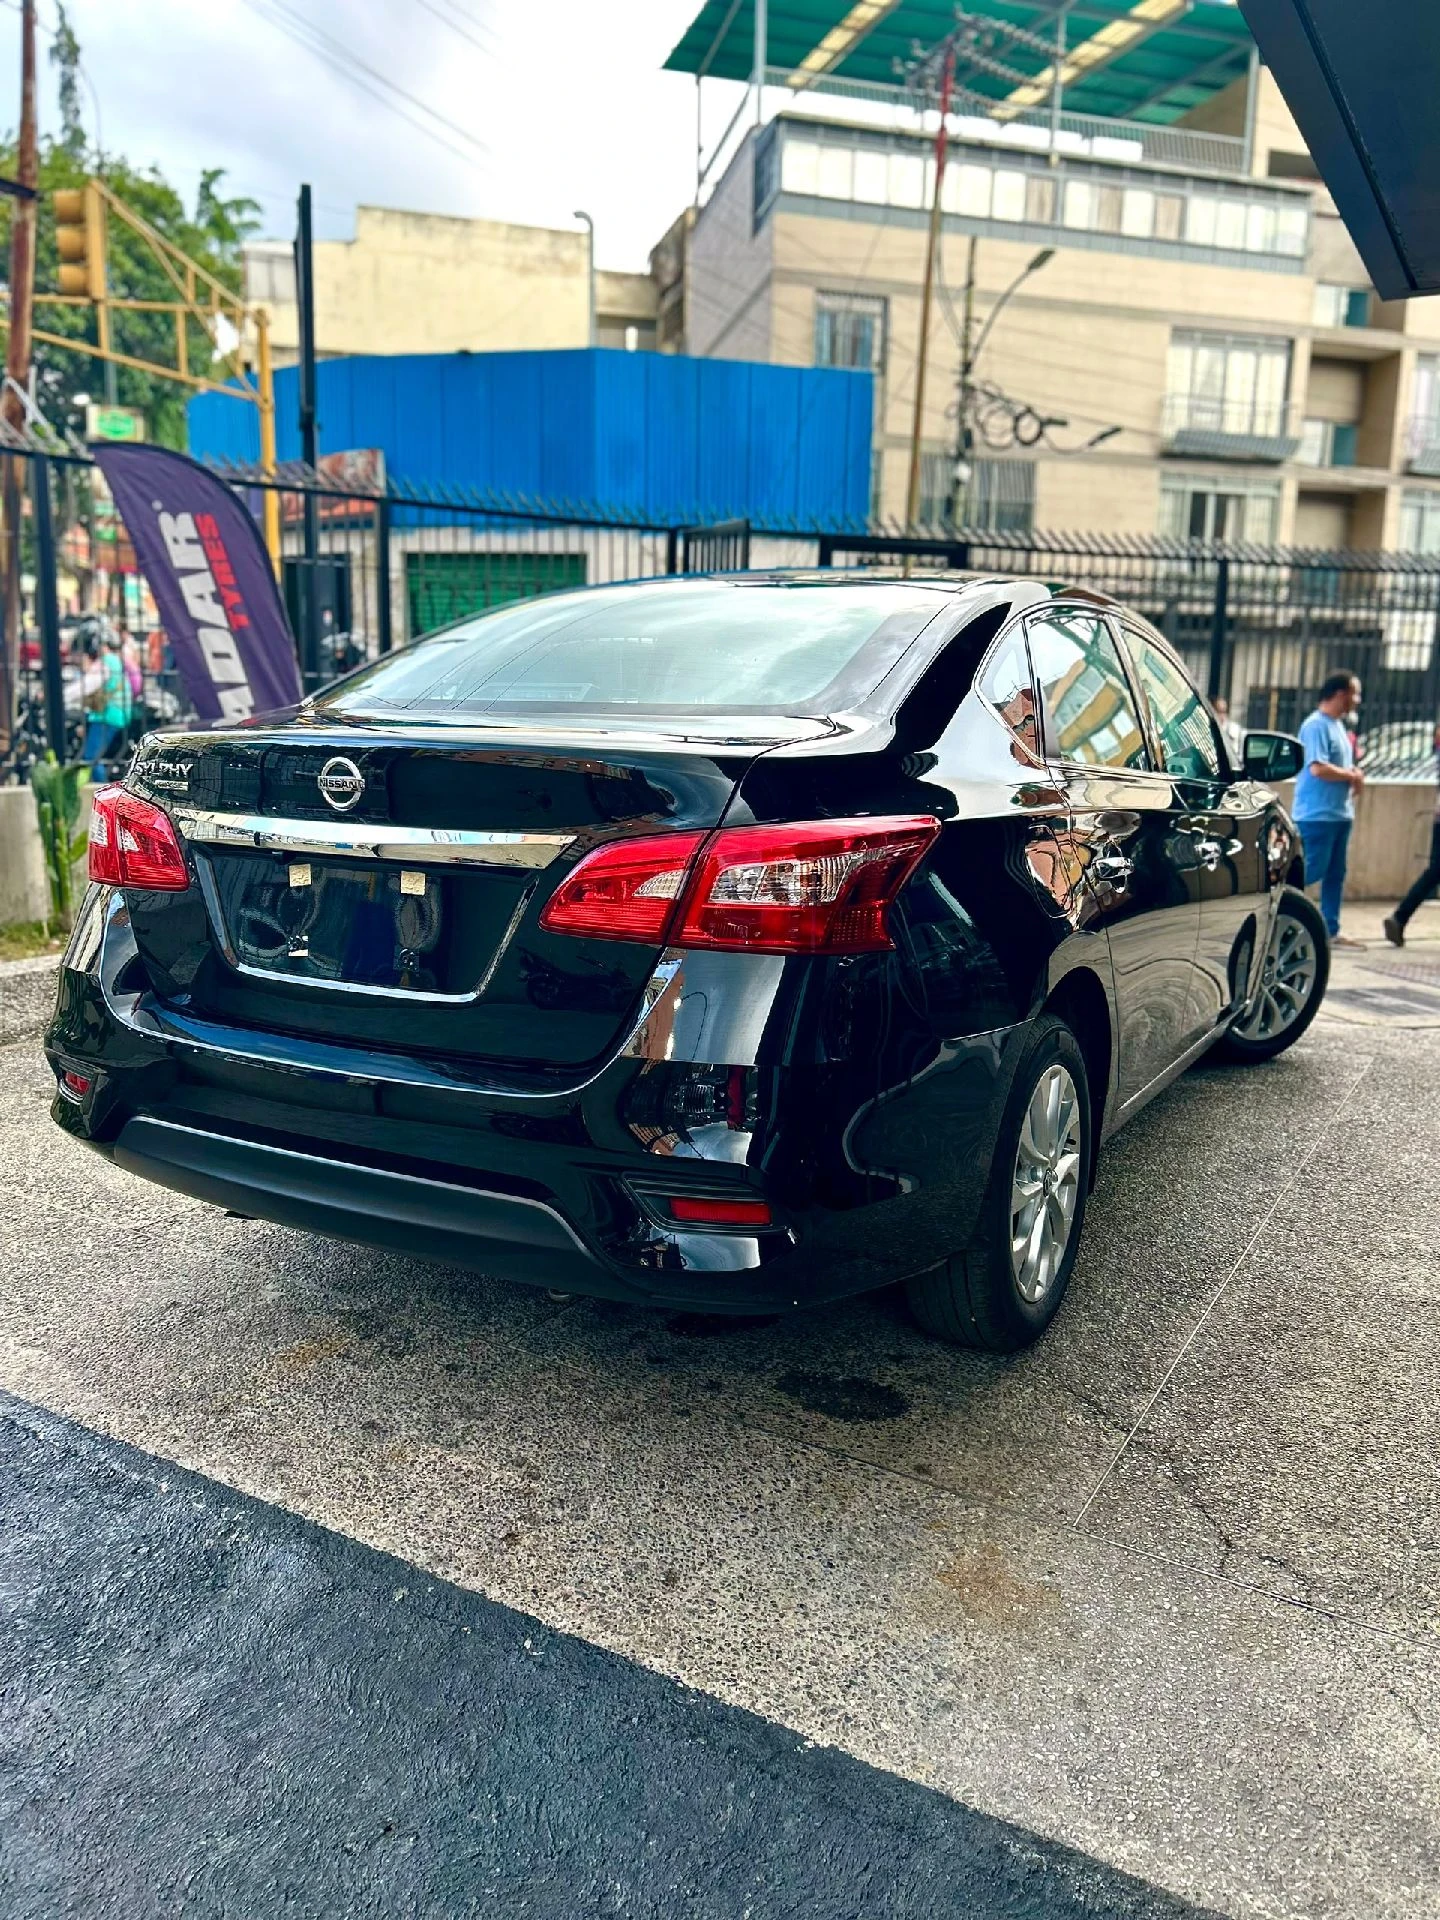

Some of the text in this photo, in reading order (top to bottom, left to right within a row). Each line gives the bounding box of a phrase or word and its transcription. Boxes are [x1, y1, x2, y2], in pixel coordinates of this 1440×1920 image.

[194, 512, 250, 632] TYRES
[134, 762, 194, 779] SYLPHY
[319, 778, 358, 790] NISSAN
